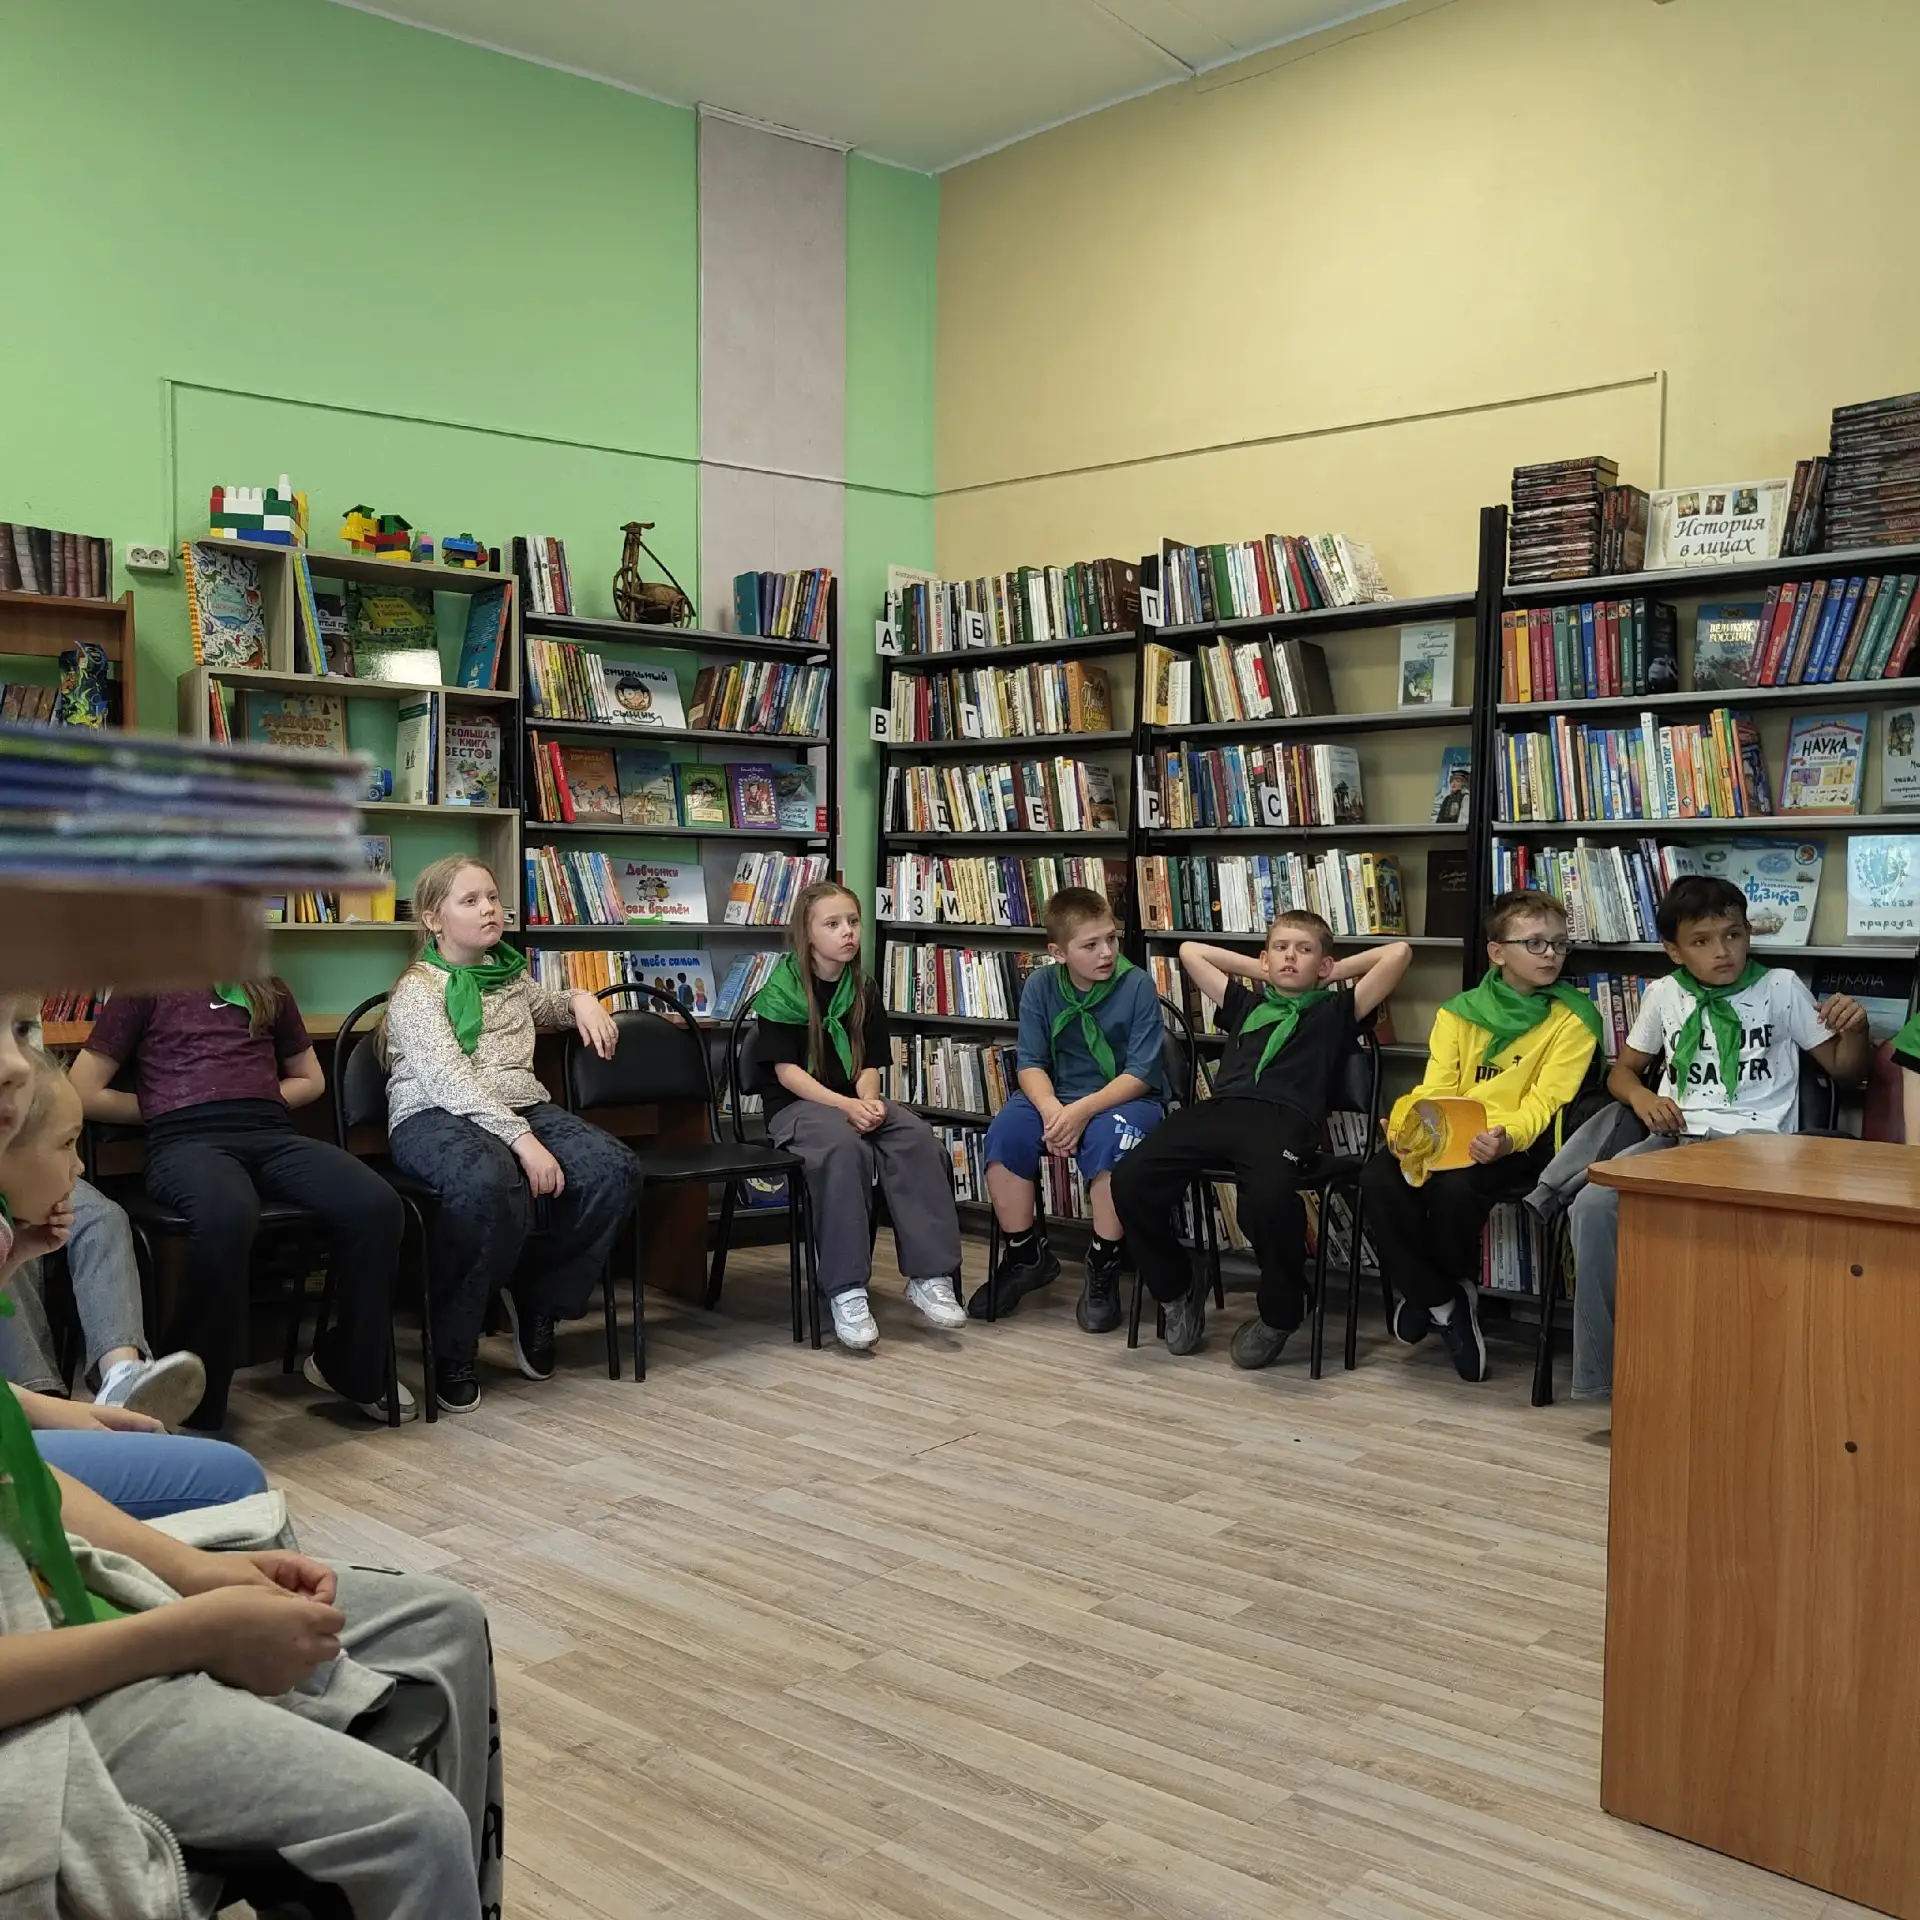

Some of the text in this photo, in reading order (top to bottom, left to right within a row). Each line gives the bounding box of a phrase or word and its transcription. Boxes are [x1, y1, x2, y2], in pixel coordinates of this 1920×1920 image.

[1674, 517, 1765, 539] История
[1680, 538, 1756, 559] в лицах
[1147, 595, 1160, 619] П
[881, 628, 895, 650] А
[972, 618, 984, 640] Б
[875, 714, 887, 735] В
[965, 710, 974, 731] Г
[451, 728, 497, 740] БОЛЬШАЯ
[459, 738, 488, 749] КНИГА
[445, 746, 493, 760] ВЕСТОВ
[1801, 736, 1848, 757] НАУКА
[937, 805, 950, 828] Д
[1033, 804, 1045, 824] Е
[1150, 797, 1160, 819] Р
[1267, 794, 1282, 818] С
[626, 862, 679, 877] Девчонки
[881, 894, 893, 914] Ж
[914, 895, 924, 916] З
[946, 896, 960, 916] И
[998, 898, 1010, 919] К
[1860, 920, 1914, 931] природа
[641, 954, 667, 967] тебе
[669, 955, 701, 967] самом
[1820, 971, 1885, 989] ЗЕРКАЛА
[1612, 994, 1622, 1012] МИР
[955, 1174, 968, 1195] Н
